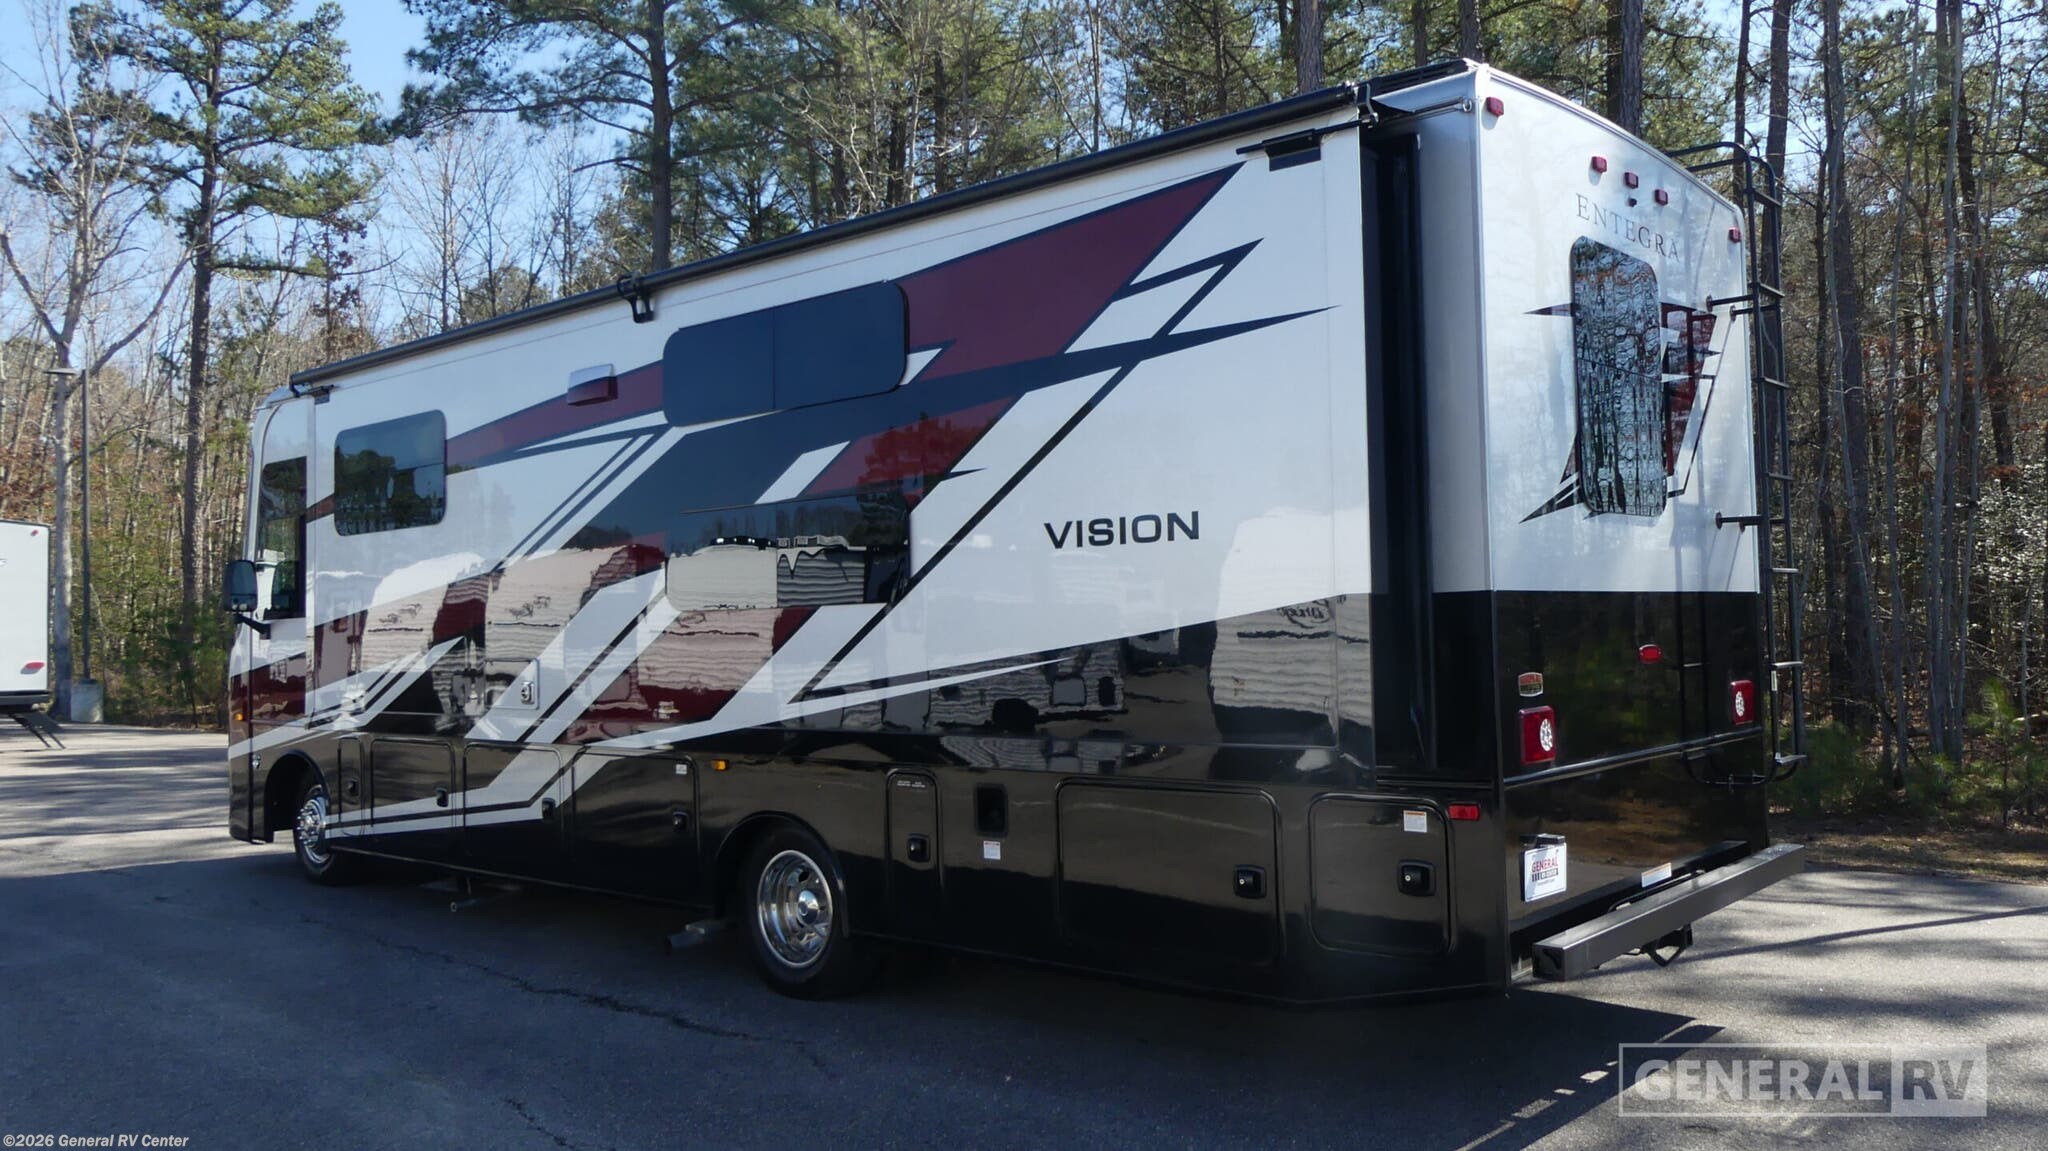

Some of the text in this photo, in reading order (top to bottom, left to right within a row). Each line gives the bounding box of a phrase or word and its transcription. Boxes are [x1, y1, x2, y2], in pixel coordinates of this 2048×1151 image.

[1575, 193, 1680, 262] ENTEGRA
[1044, 510, 1199, 549] VISION
[1531, 857, 1559, 873] GENERAL
